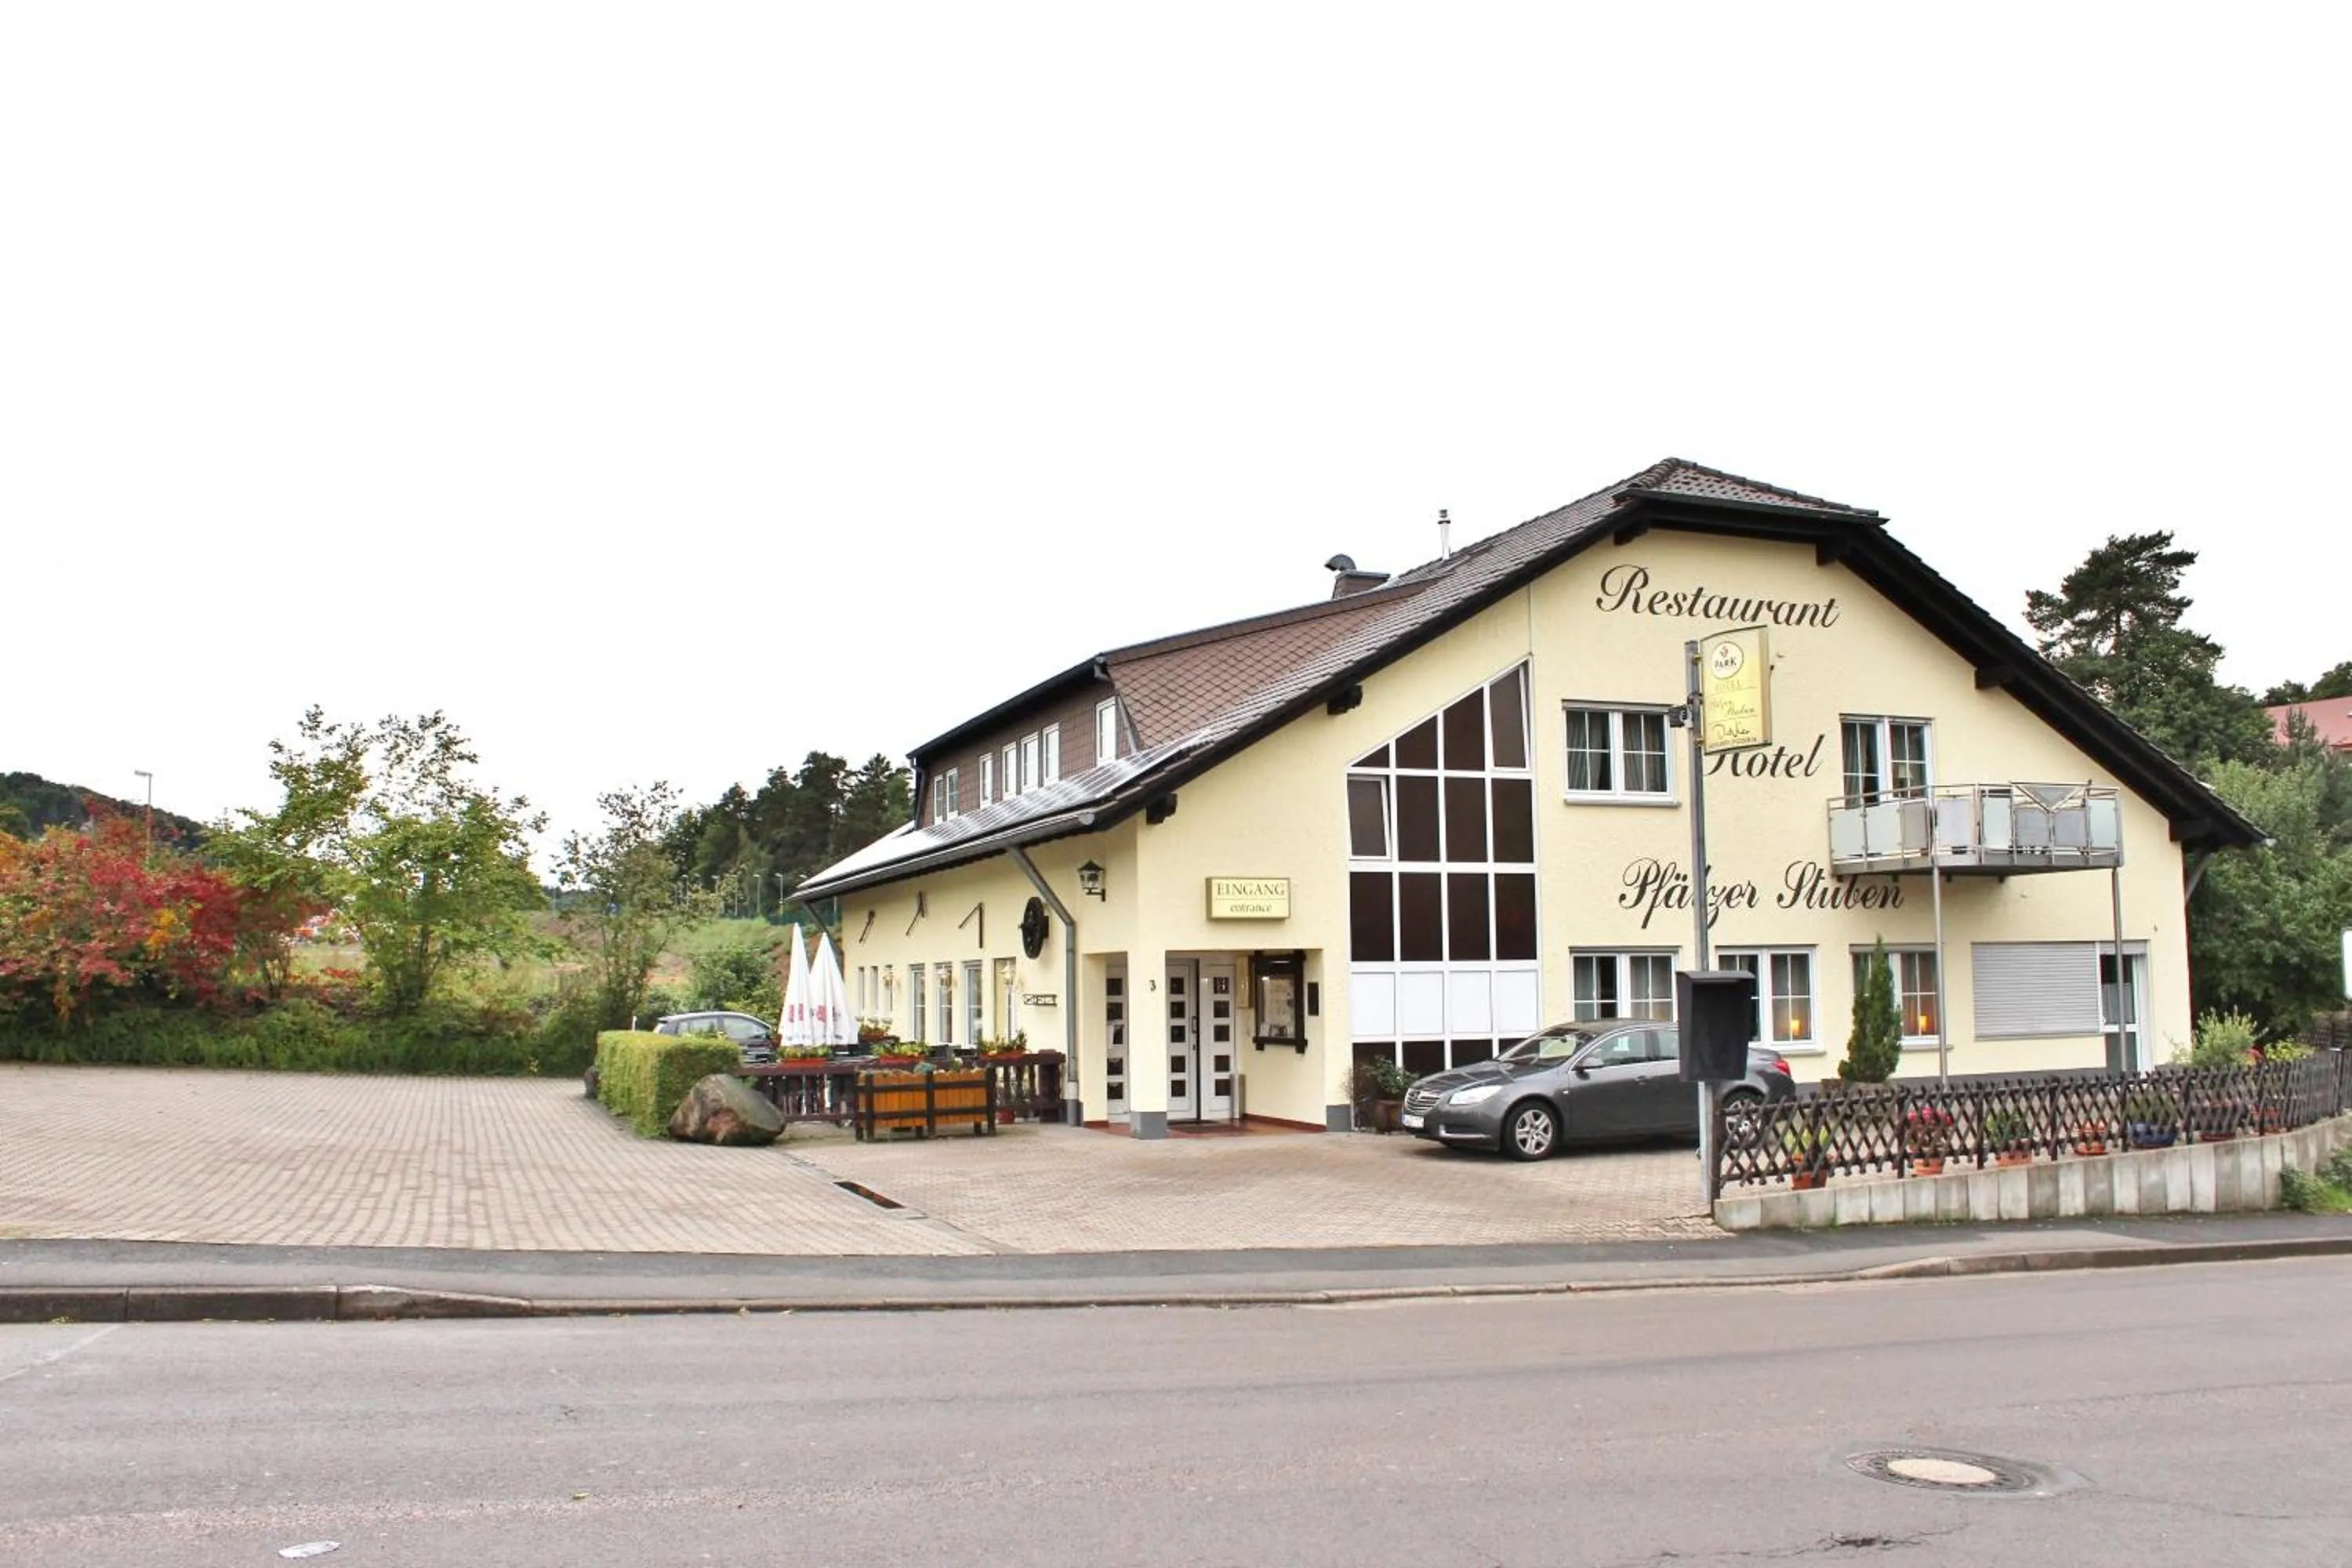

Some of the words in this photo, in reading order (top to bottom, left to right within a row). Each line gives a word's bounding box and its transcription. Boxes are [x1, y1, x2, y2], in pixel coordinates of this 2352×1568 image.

[1595, 564, 1840, 628] Restaurant
[1217, 883, 1285, 896] EINGANG
[1618, 857, 1760, 931] Pfäzer
[1777, 860, 1904, 910] Stuben
[1149, 979, 1156, 992] 3
